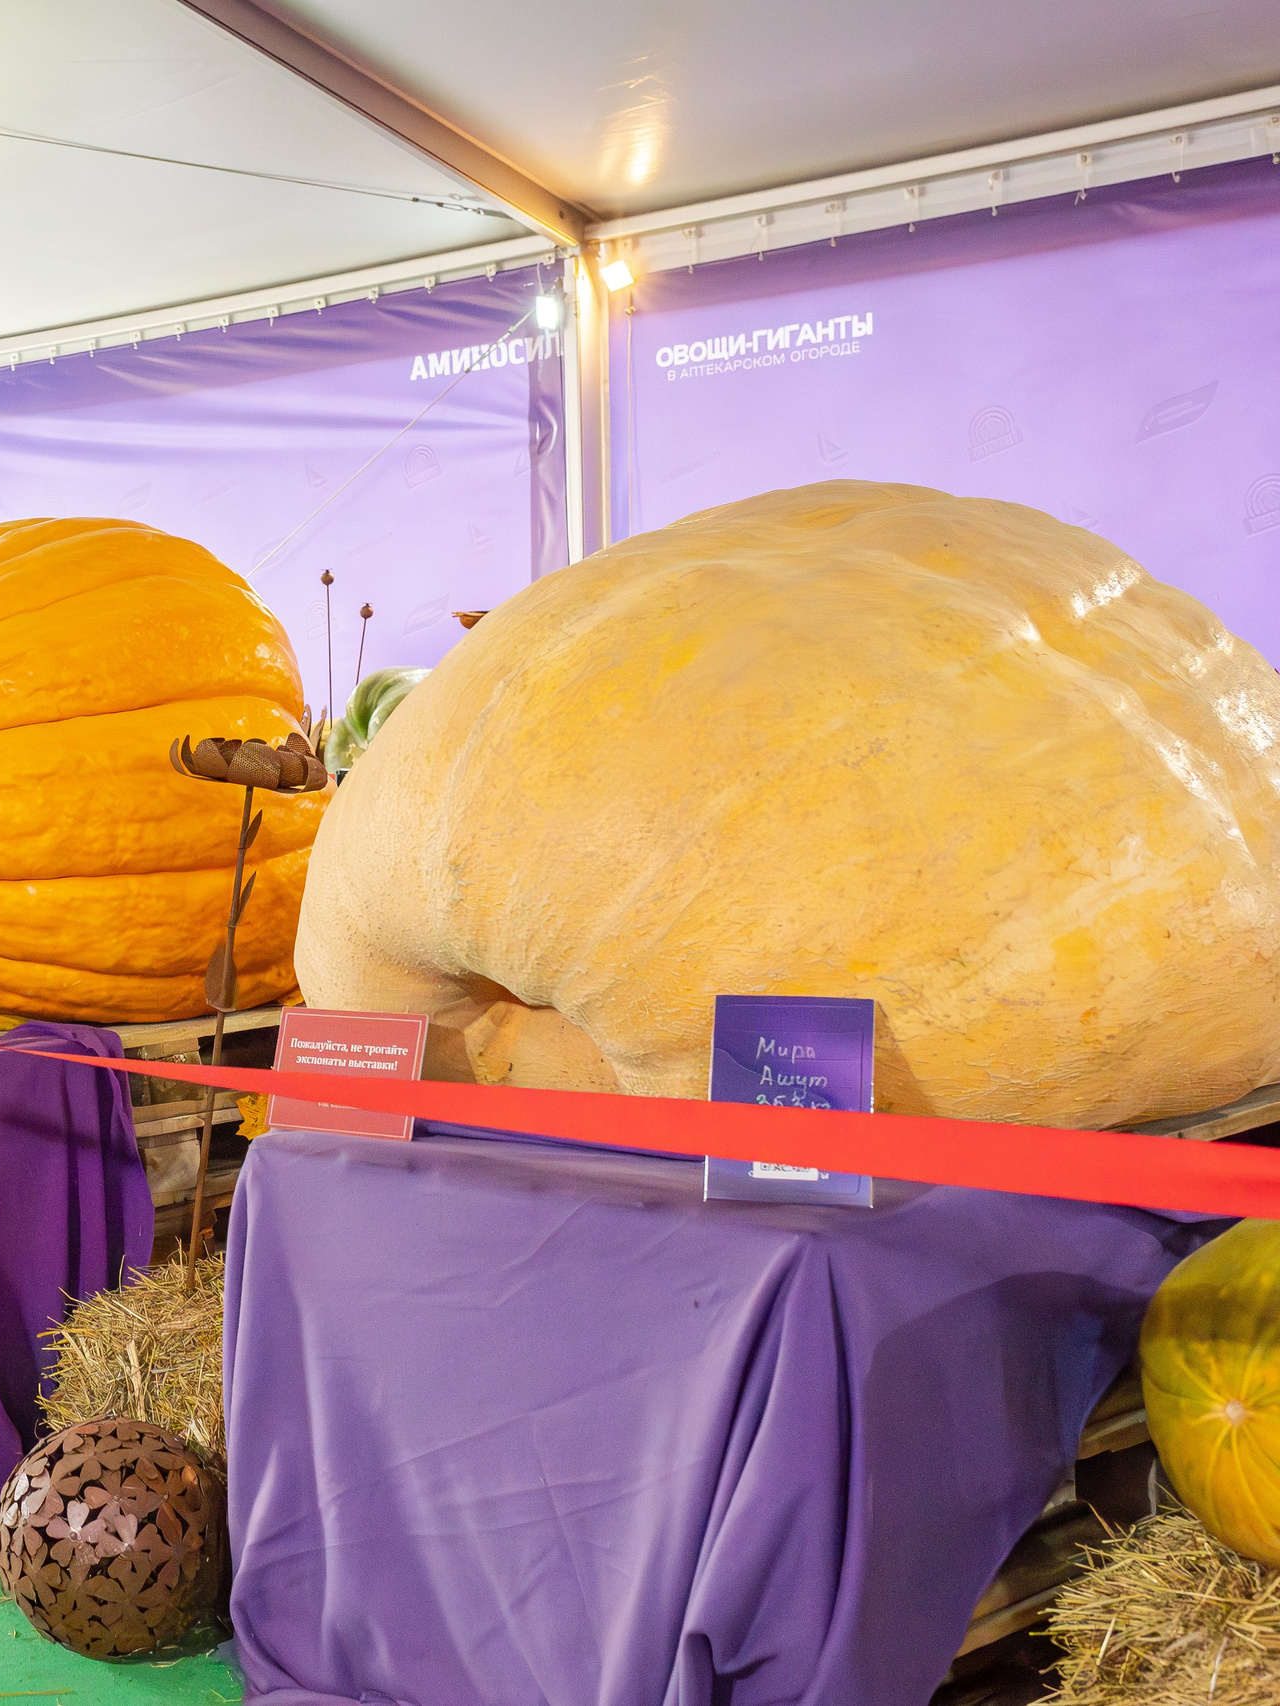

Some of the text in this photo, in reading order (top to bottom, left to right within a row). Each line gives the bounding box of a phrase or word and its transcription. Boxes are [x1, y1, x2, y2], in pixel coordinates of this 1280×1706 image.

[655, 311, 874, 368] ОВОЩИ-ГИГАНТЫ
[667, 341, 862, 382] В АПТЕКАРСКОМ ОГОРОДЕ
[290, 1037, 409, 1057] Пожалуйста, не трогайте
[295, 1055, 398, 1071] экспонаты выставки!
